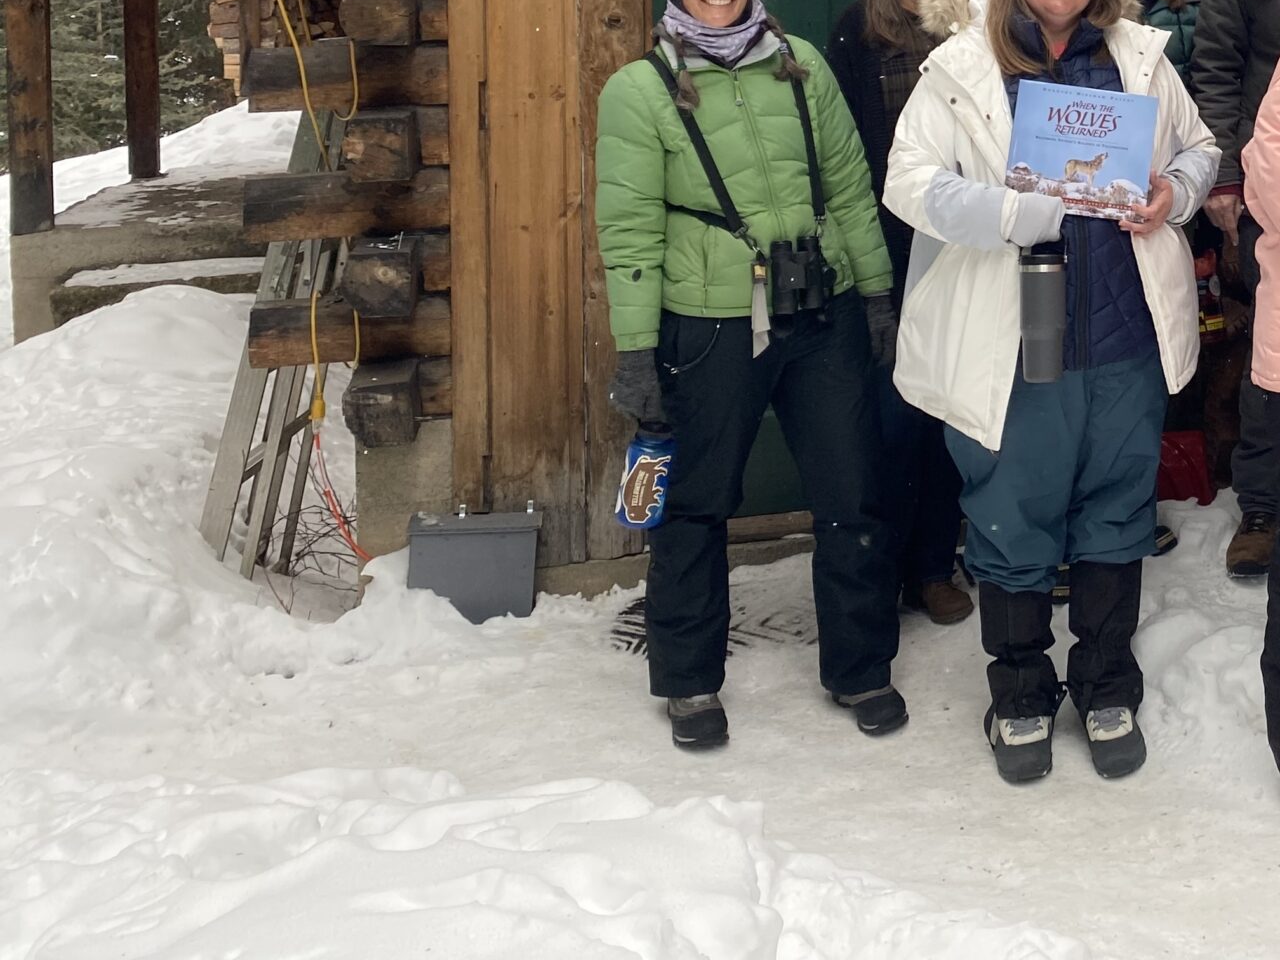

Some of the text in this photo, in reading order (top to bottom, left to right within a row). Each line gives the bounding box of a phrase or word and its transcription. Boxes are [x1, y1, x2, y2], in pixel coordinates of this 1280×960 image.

[1072, 100, 1115, 113] WHEN THE
[1047, 105, 1122, 132] WOLVES
[1055, 125, 1108, 138] RETURNED
